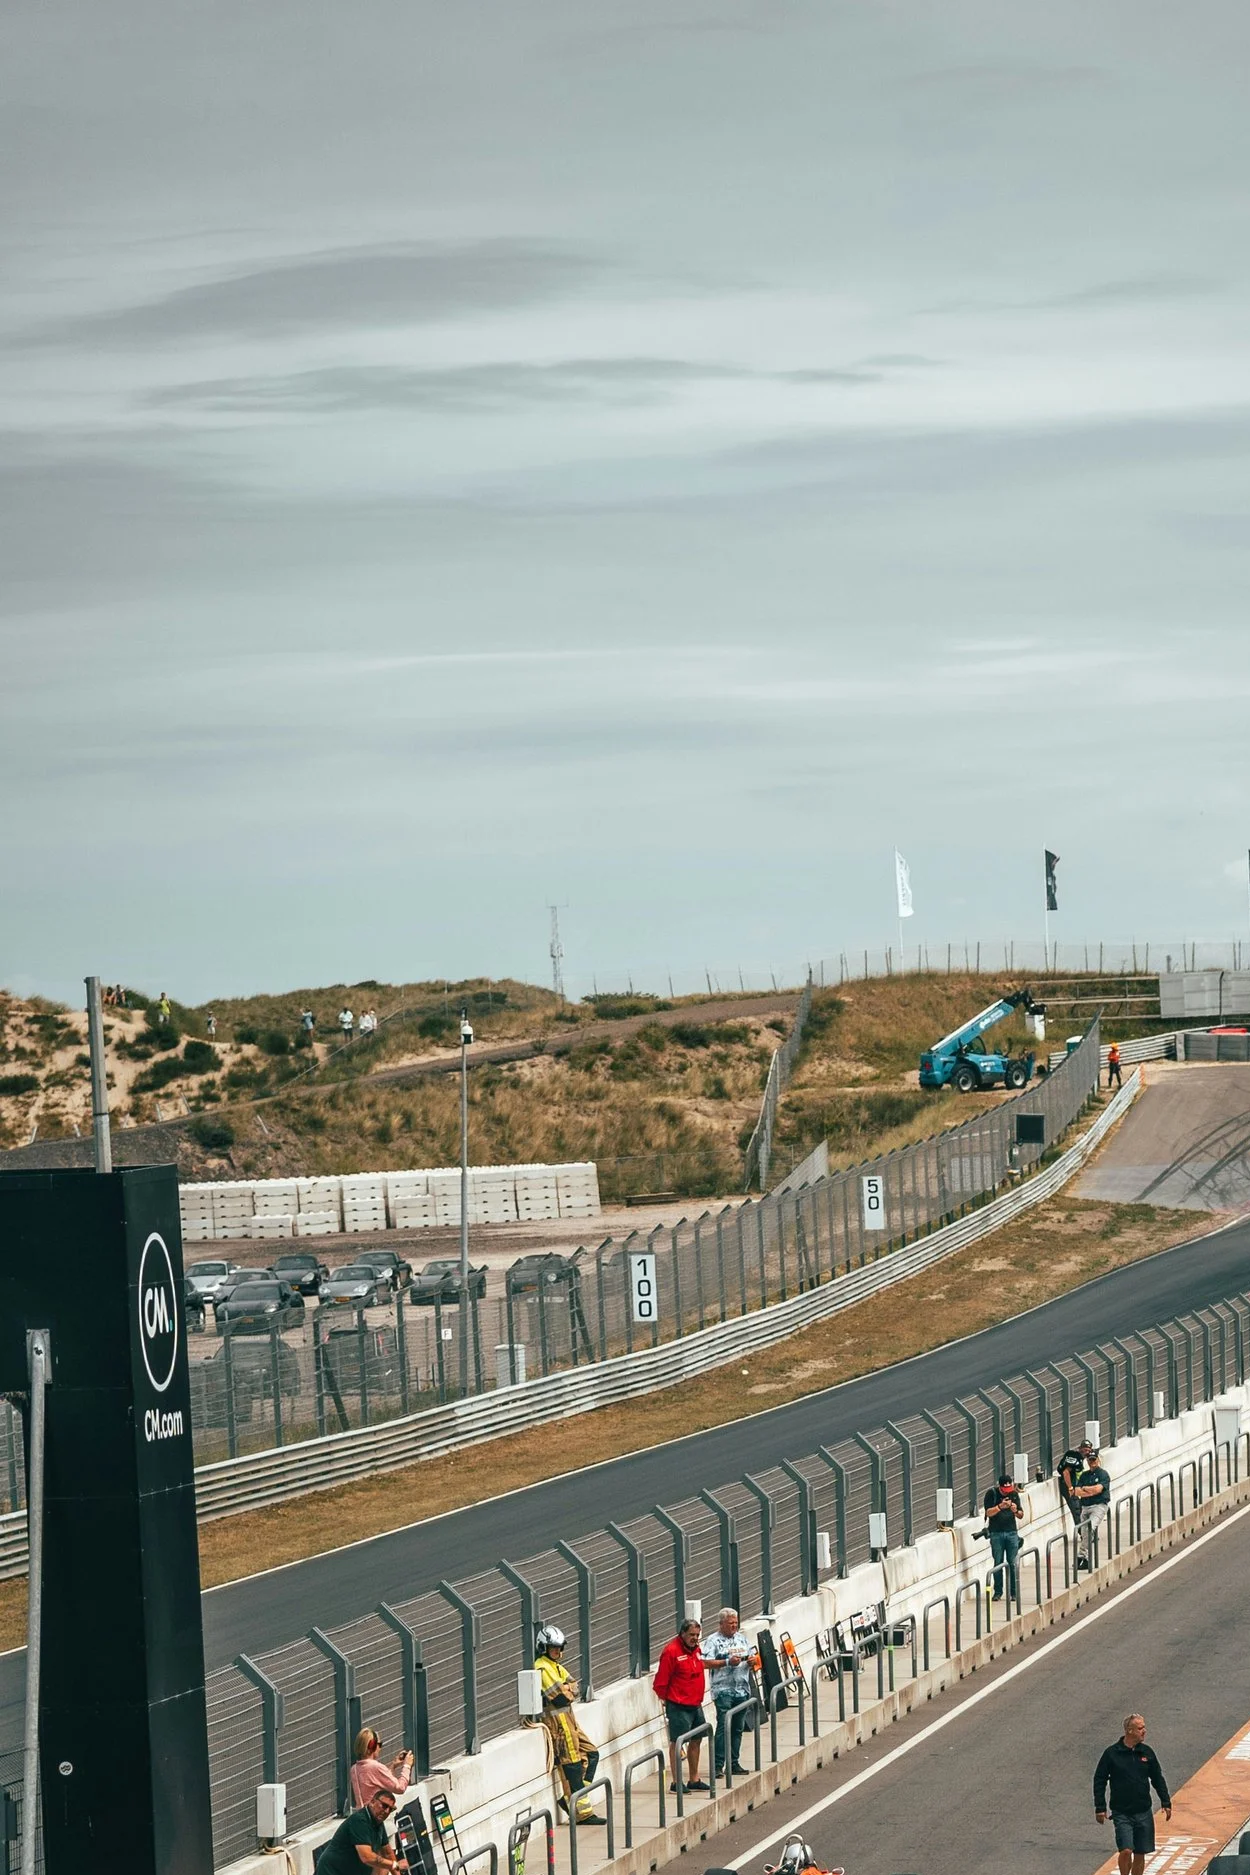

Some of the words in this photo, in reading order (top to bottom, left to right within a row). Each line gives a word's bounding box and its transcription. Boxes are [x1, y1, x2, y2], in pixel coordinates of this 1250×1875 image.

[868, 1180, 879, 1210] 50
[637, 1258, 653, 1318] 100
[144, 1407, 184, 1442] CM.com
